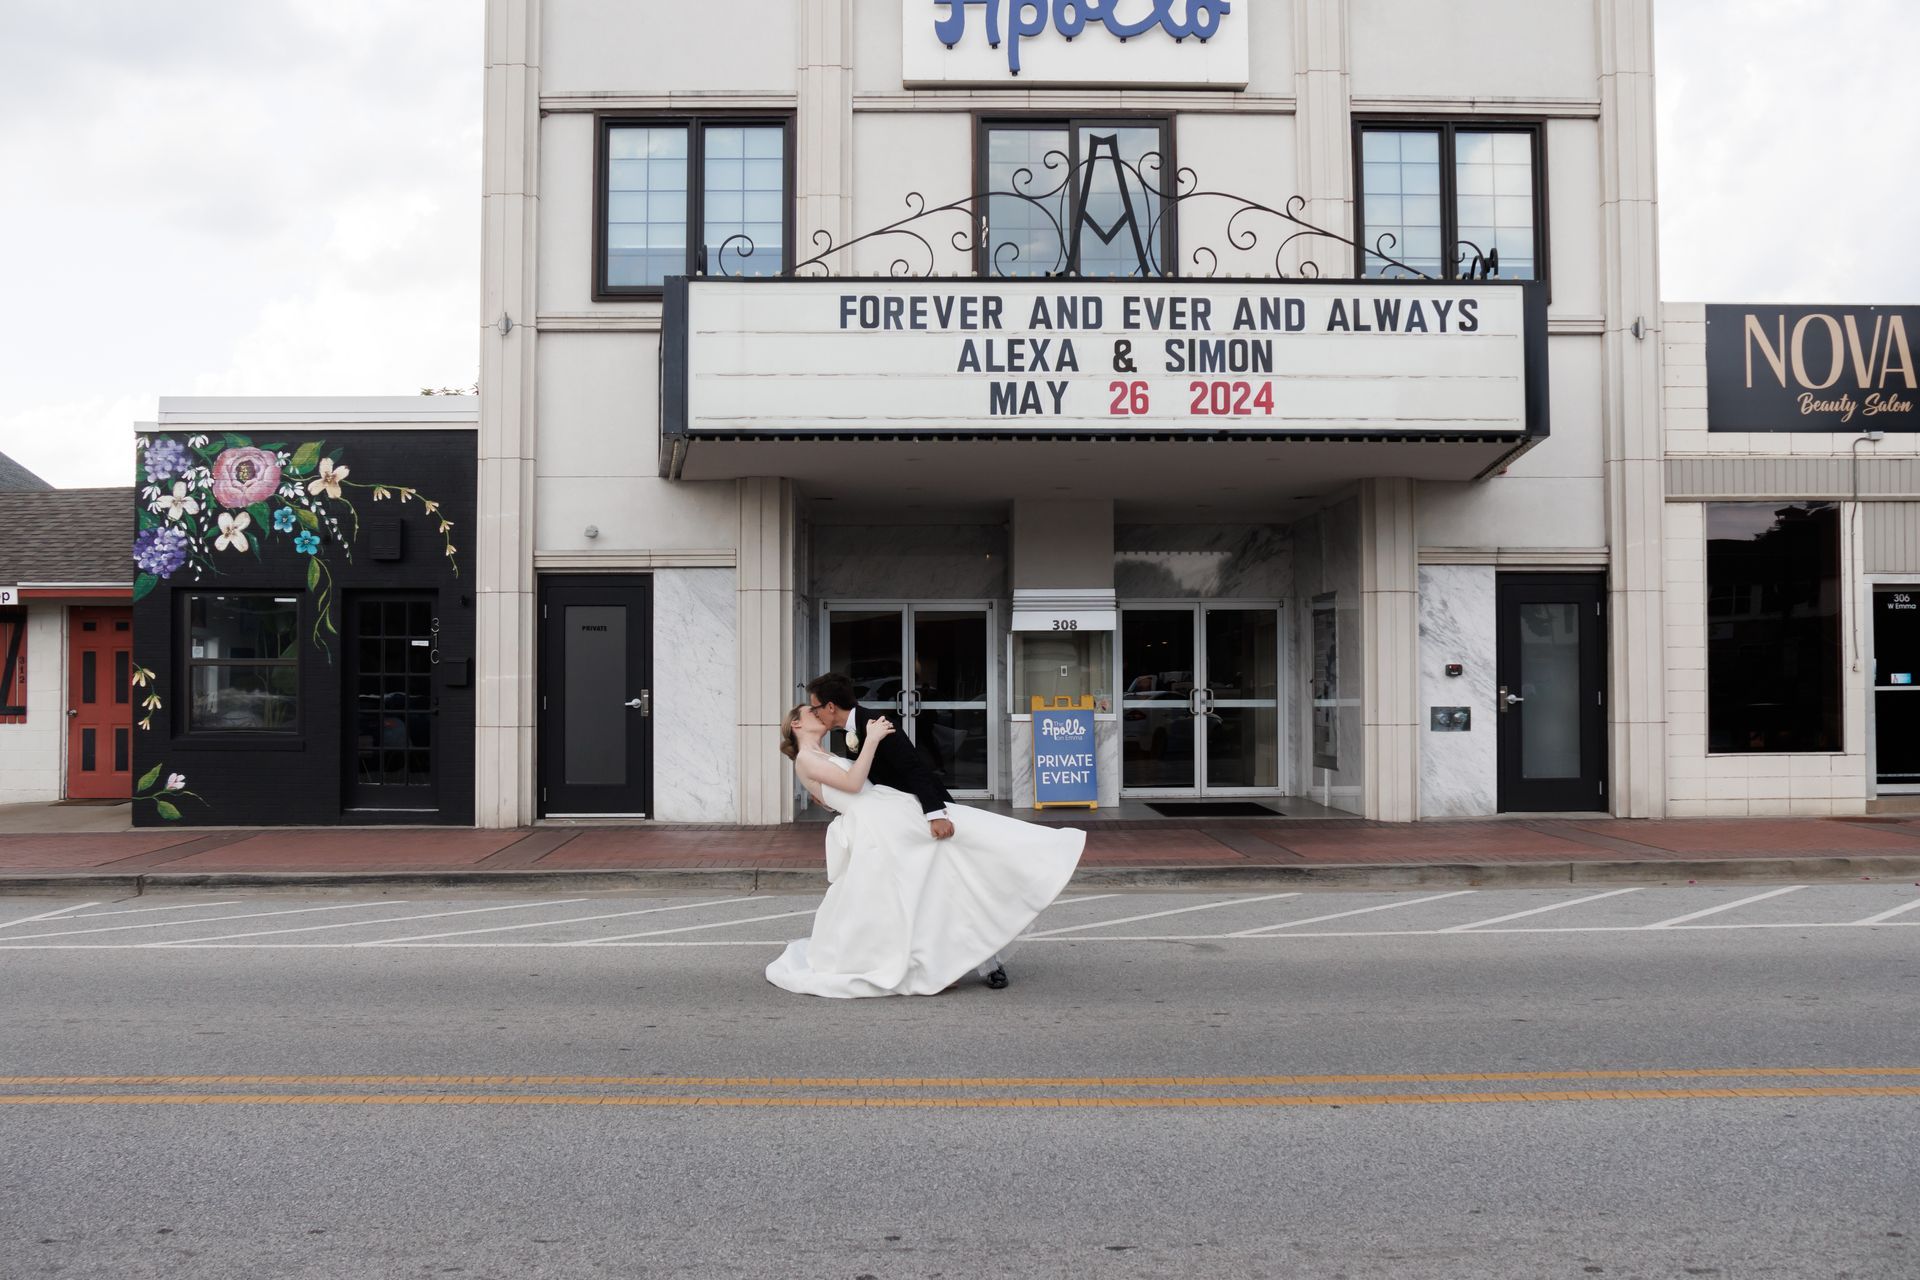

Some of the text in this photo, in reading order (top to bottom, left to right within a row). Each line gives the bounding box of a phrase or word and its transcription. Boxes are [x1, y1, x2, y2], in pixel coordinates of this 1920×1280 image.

[840, 295, 1479, 333] FOREVER AND EVER AND ALWAYS
[957, 338, 1273, 373] ALEXA & SIMON
[1744, 313, 1918, 390] NOVA
[990, 380, 1276, 416] MAY 26 2024
[1797, 392, 1914, 423] Beauty Salon
[0, 591, 10, 604] p
[1893, 593, 1910, 603] 306
[1052, 619, 1078, 630] 308
[1042, 718, 1087, 741] Apollo
[1037, 753, 1094, 768] PRIVATE
[1042, 770, 1091, 785] EVENT
